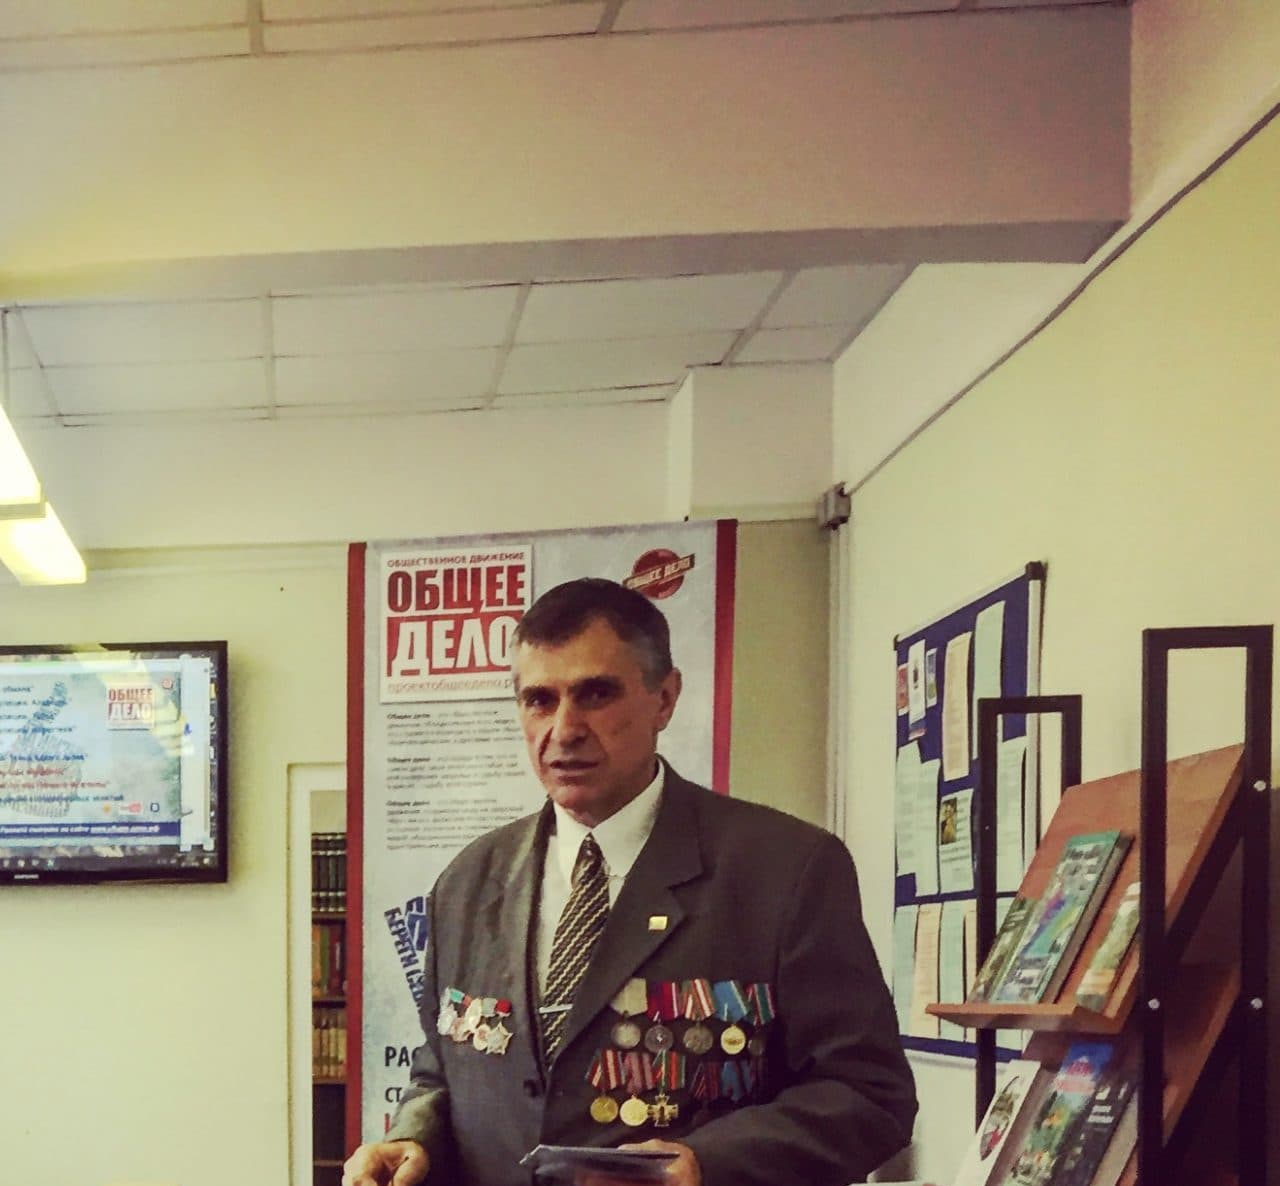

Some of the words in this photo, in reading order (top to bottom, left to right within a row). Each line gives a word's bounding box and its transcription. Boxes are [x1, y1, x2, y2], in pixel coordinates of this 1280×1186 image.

[387, 553, 467, 567] ОБЩЕСТВЕННОЕ
[469, 552, 525, 564] ДВИЖЕНИЕ
[388, 565, 526, 613] ОБЩЕЕ
[391, 615, 519, 677] ДЕЛО
